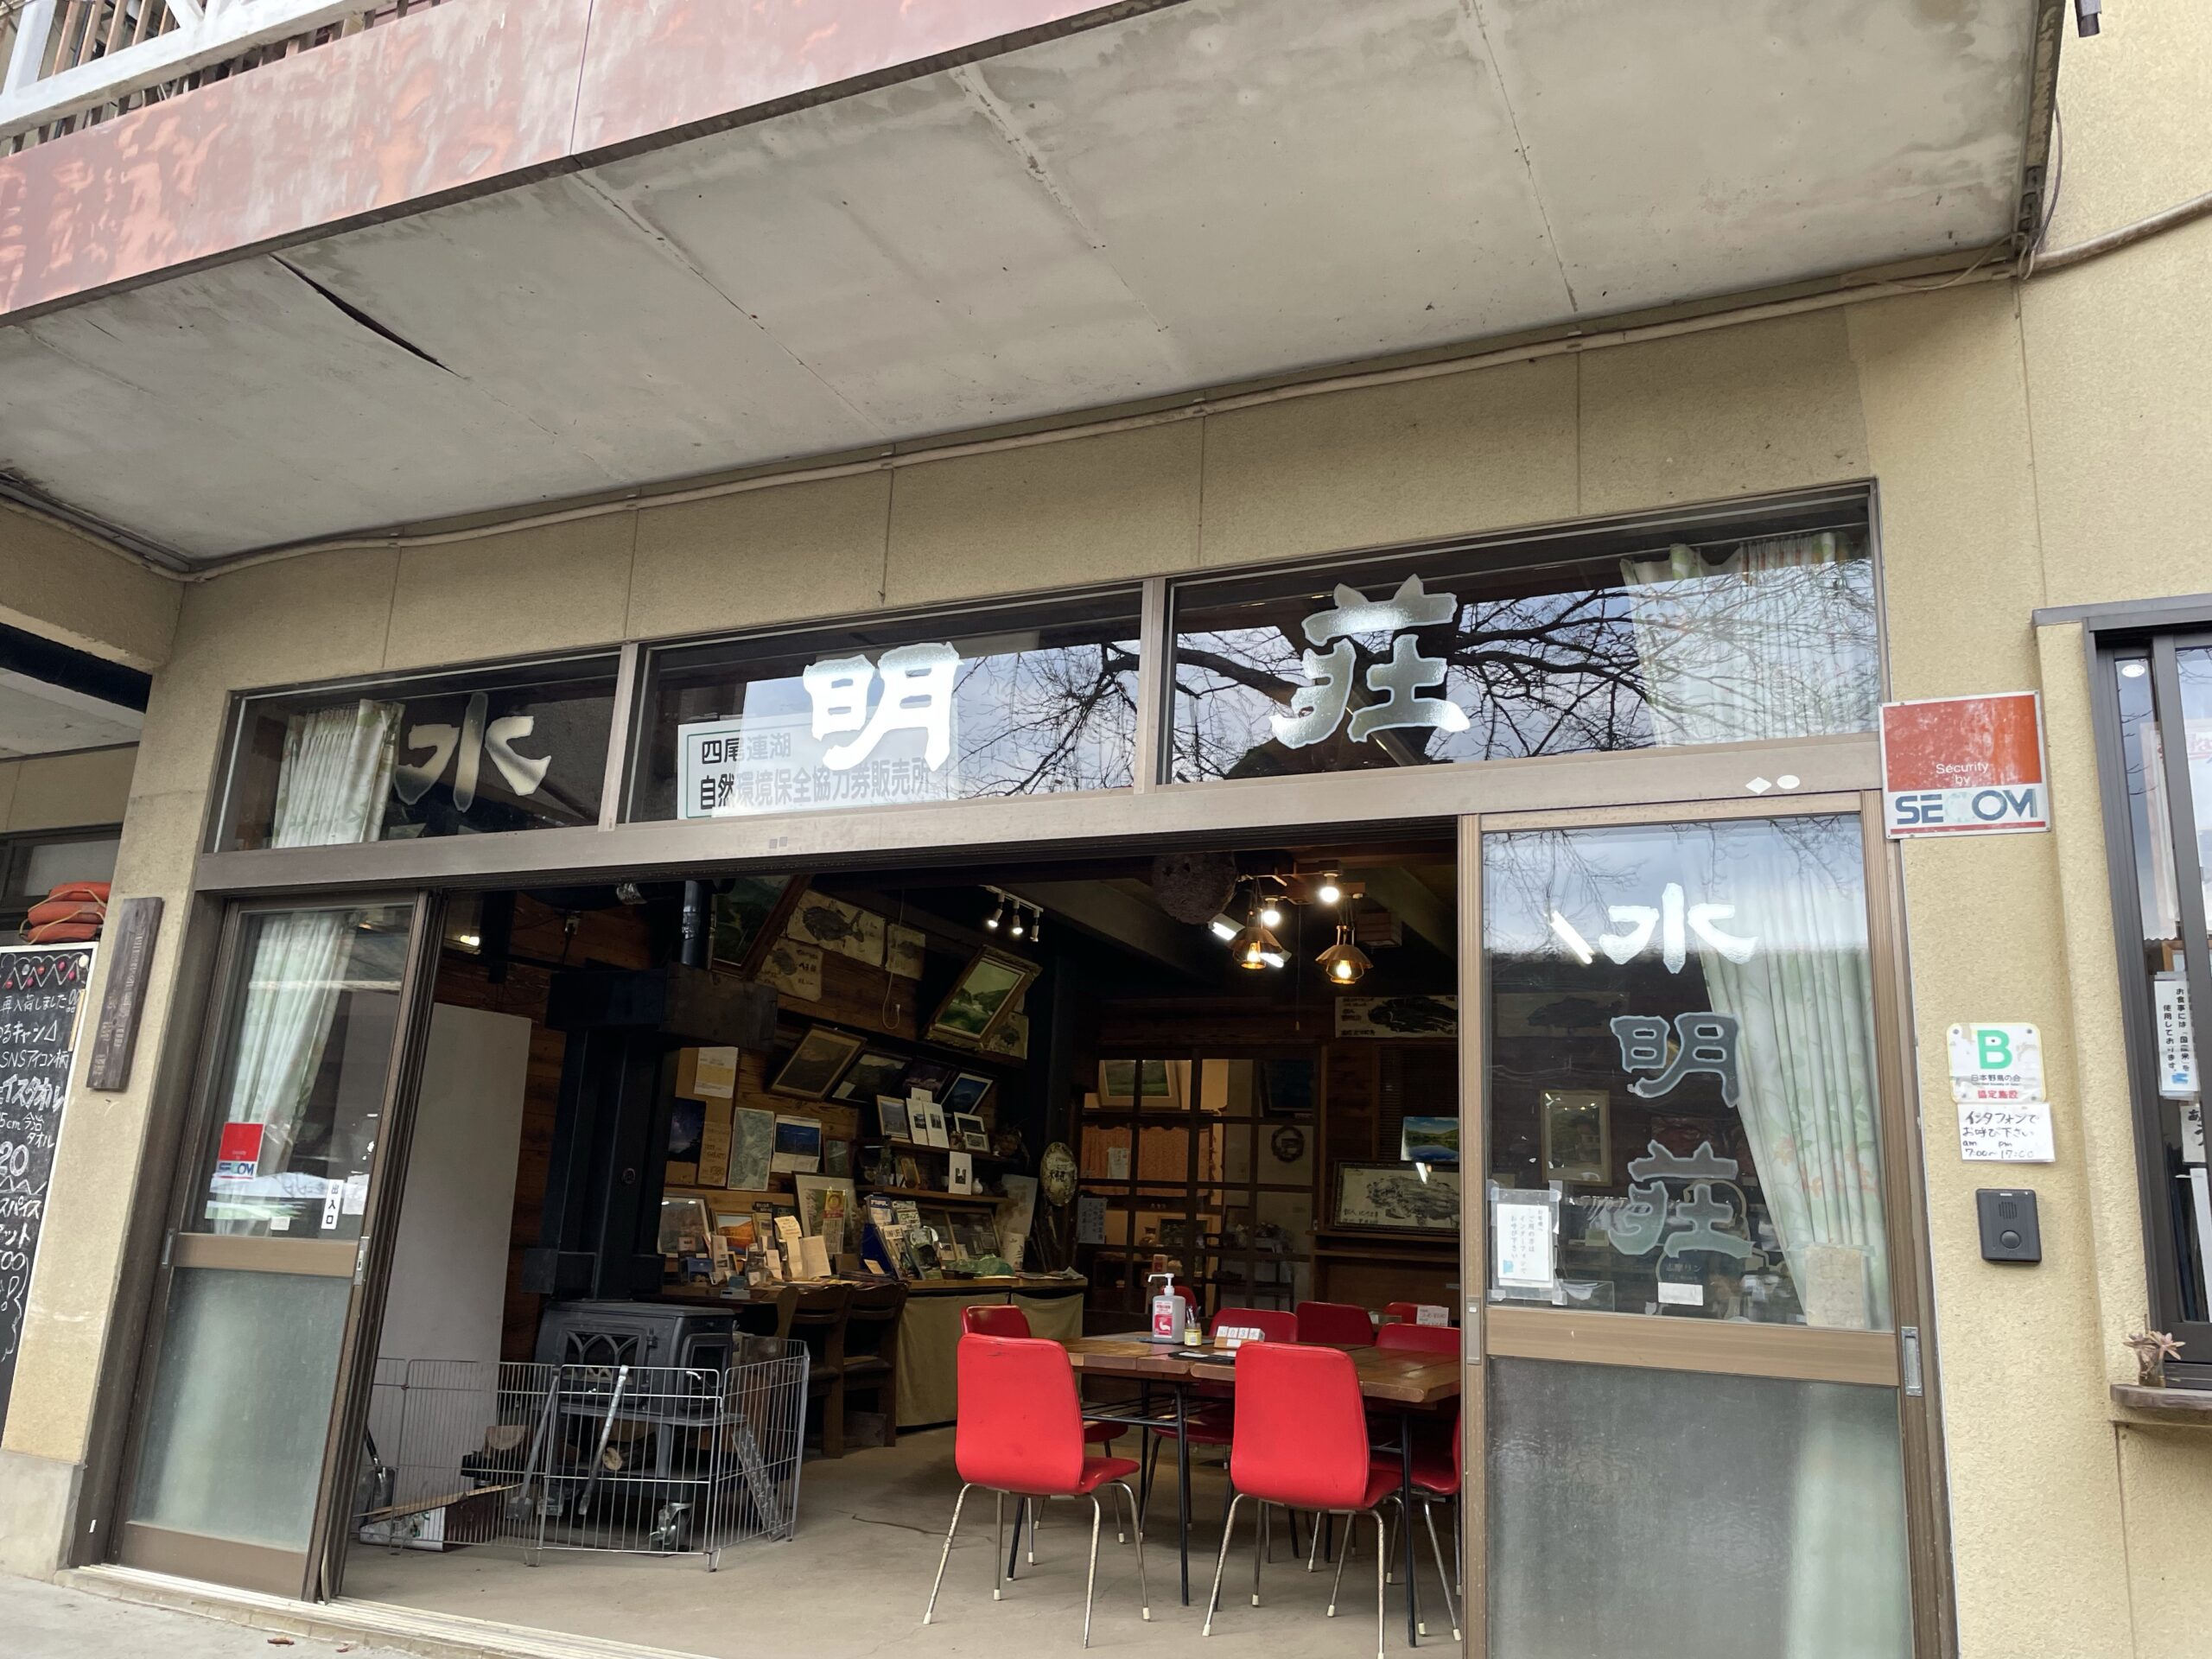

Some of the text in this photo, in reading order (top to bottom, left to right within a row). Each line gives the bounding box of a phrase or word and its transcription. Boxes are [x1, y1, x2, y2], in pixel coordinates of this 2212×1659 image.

[803, 641, 961, 772] 明
[702, 733, 791, 765] 四尾連湖
[1936, 761, 1989, 774] Security
[1955, 774, 1970, 785] by
[1896, 789, 2037, 824] SEOM
[1977, 1030, 2012, 1069] B
[27, 1132, 55, 1148] タオル
